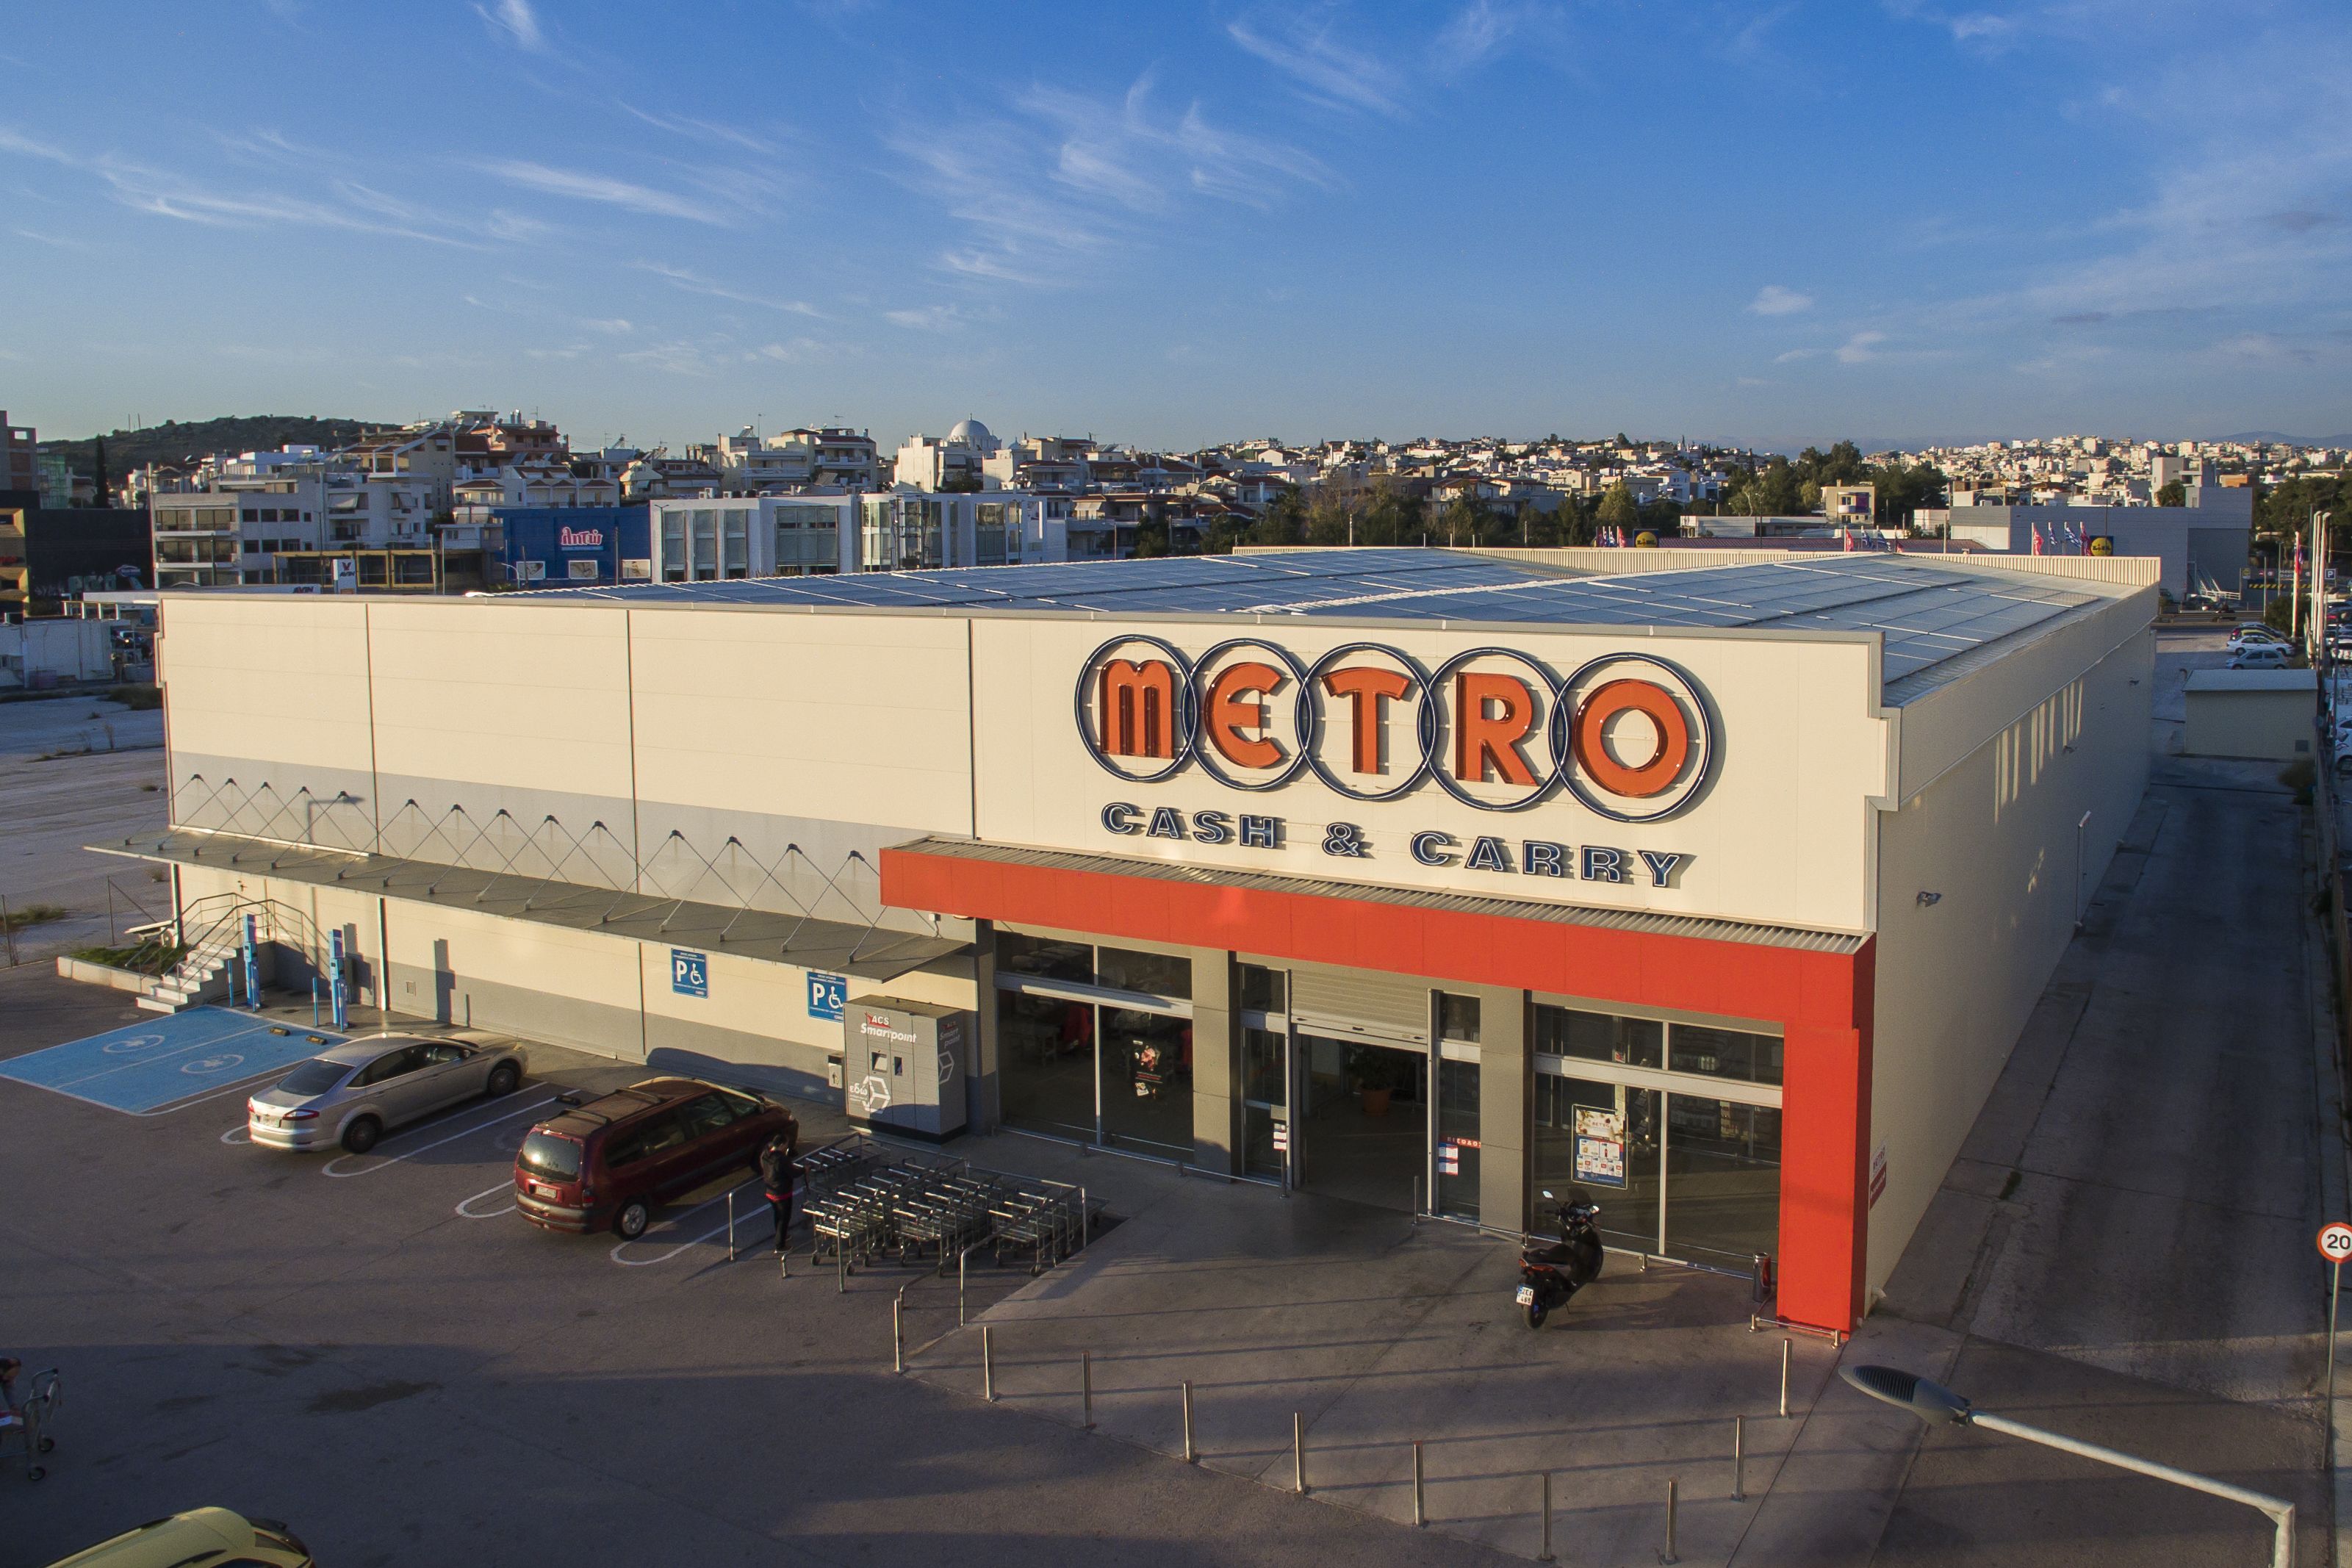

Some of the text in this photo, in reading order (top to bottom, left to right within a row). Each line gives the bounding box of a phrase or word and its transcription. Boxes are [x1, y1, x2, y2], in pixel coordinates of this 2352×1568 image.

[2327, 570, 2334, 578] P
[1099, 658, 1689, 798] METRO
[1101, 802, 1682, 888] CASH & CARRY
[677, 960, 688, 982] P
[813, 982, 825, 1006] P
[871, 1015, 890, 1025] ACS
[860, 1023, 917, 1043] Smartpoint
[2327, 1234, 2351, 1250] 20
